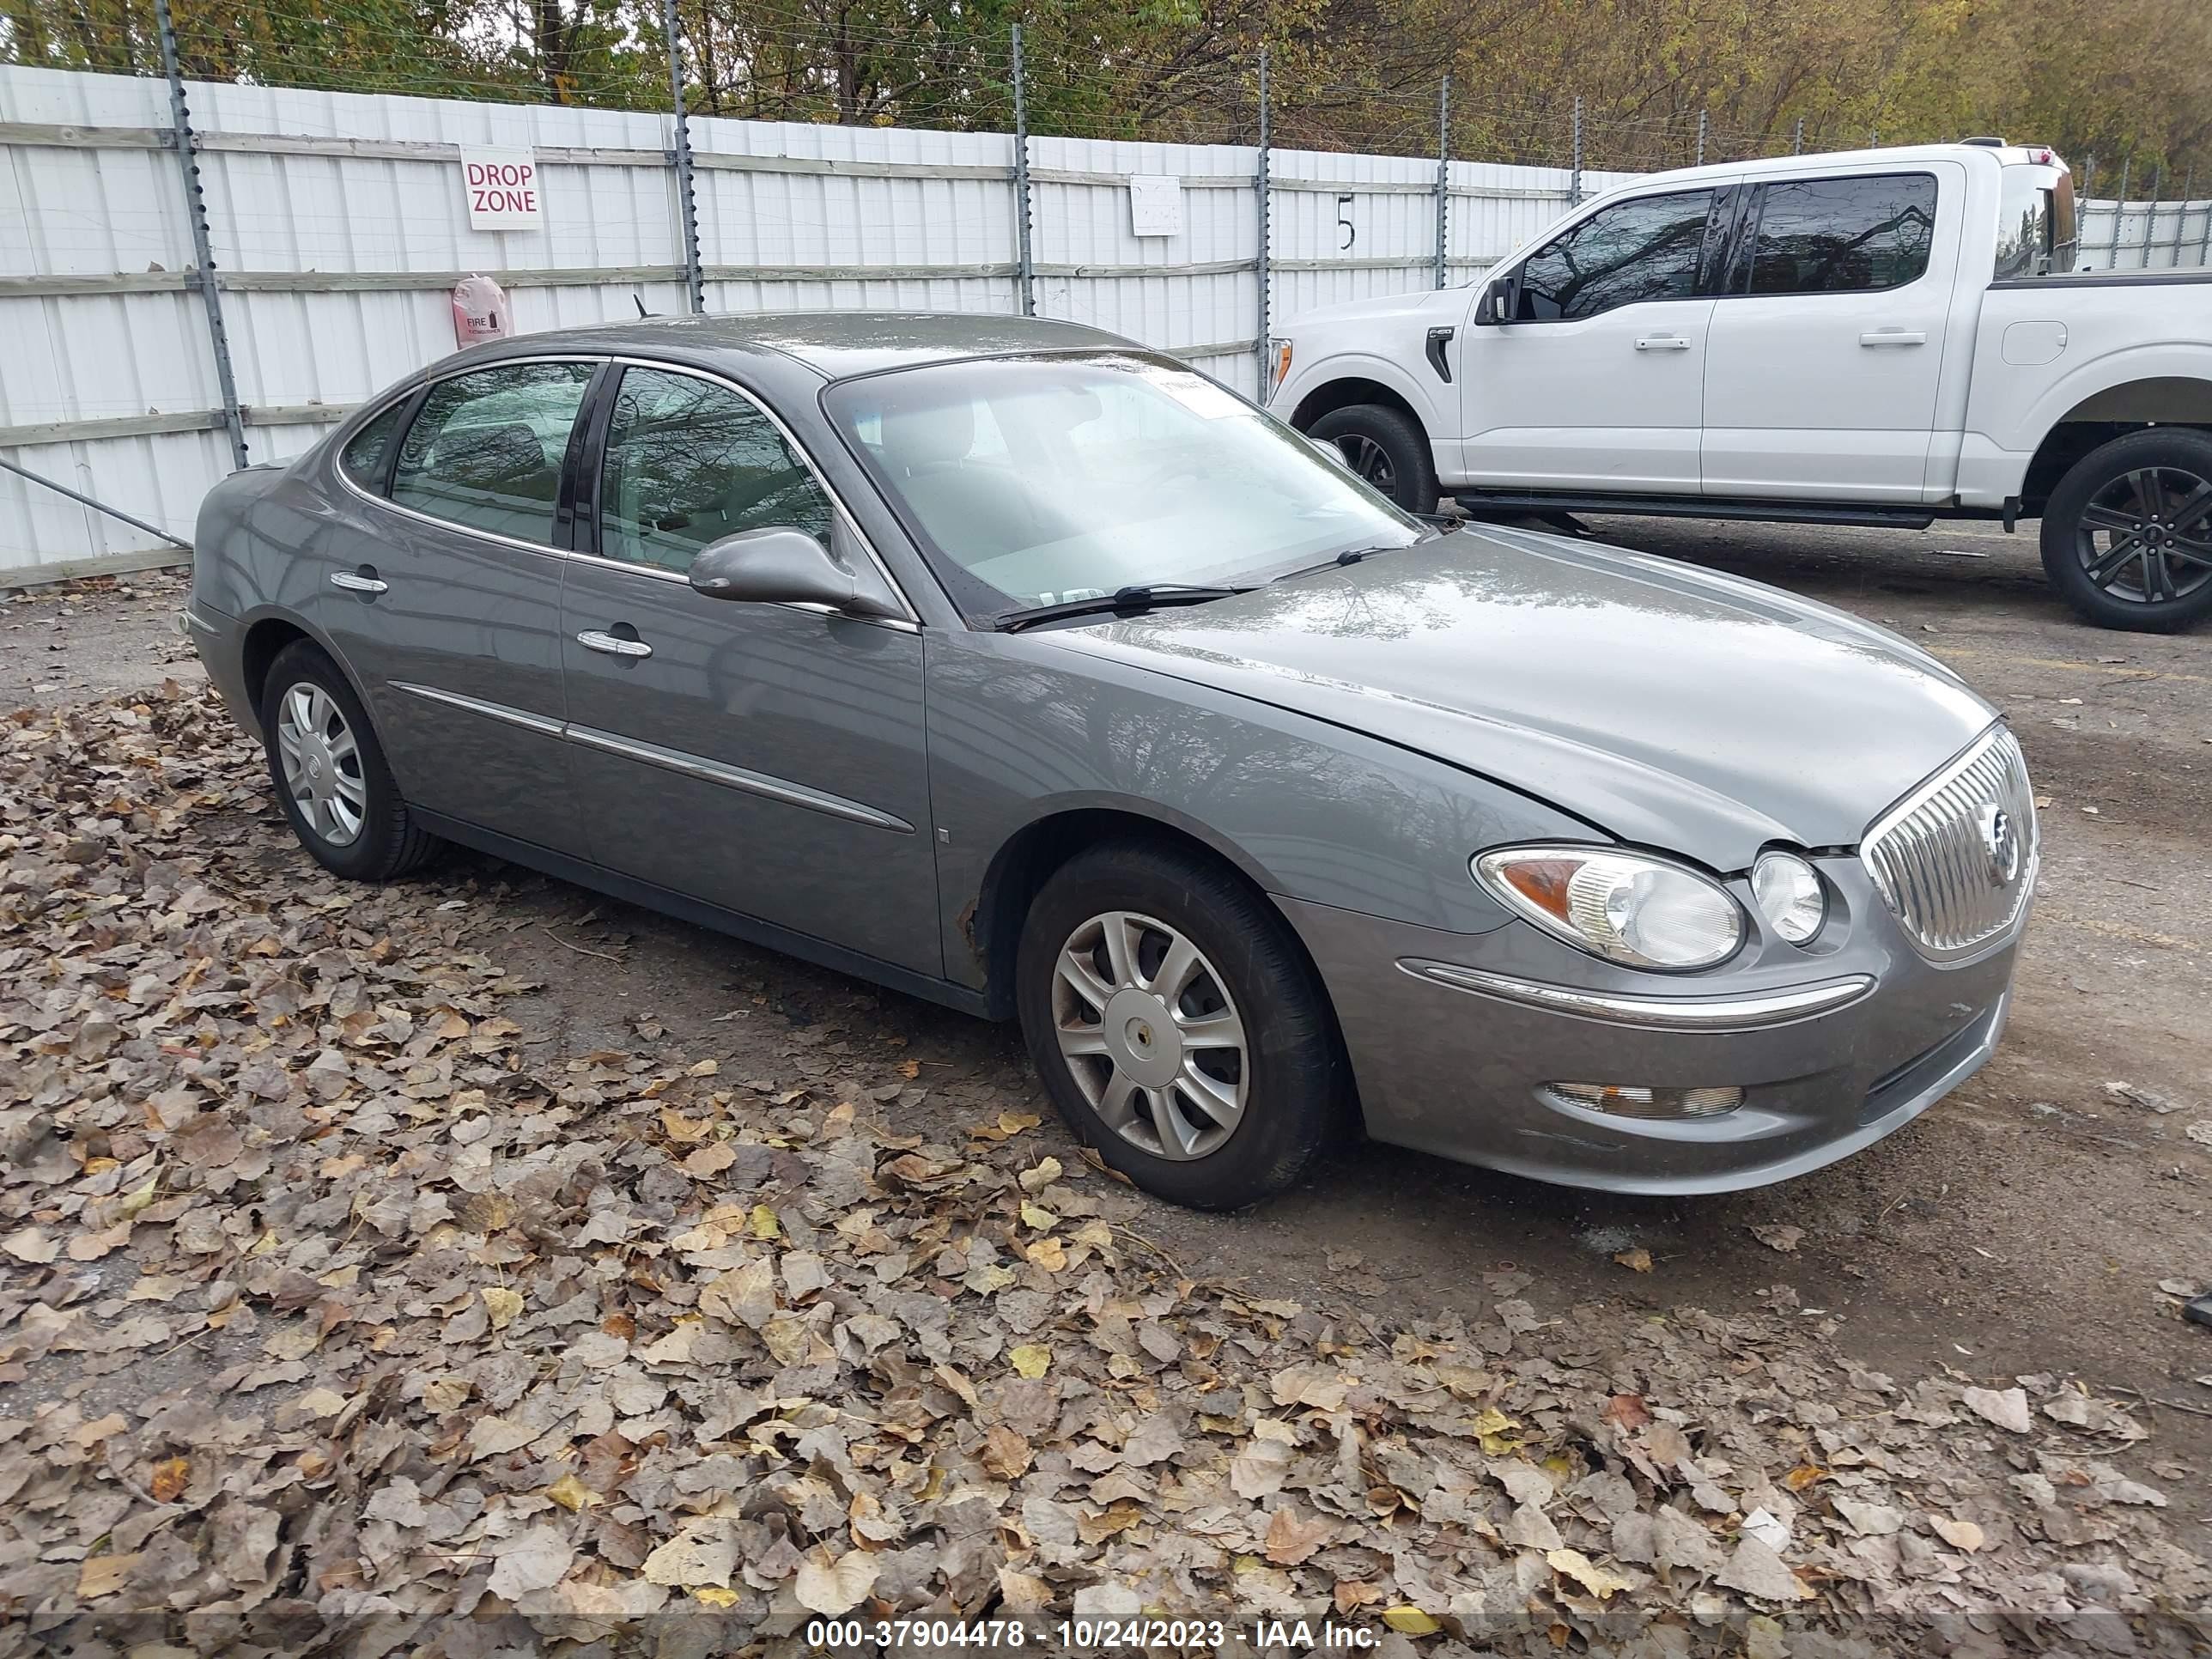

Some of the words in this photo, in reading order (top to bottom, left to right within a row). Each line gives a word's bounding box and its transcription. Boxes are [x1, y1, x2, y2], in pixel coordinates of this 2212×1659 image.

[467, 163, 532, 186] DROP
[471, 190, 537, 213] ZONE
[1338, 196, 1355, 249] 5
[467, 318, 487, 327] FIRE
